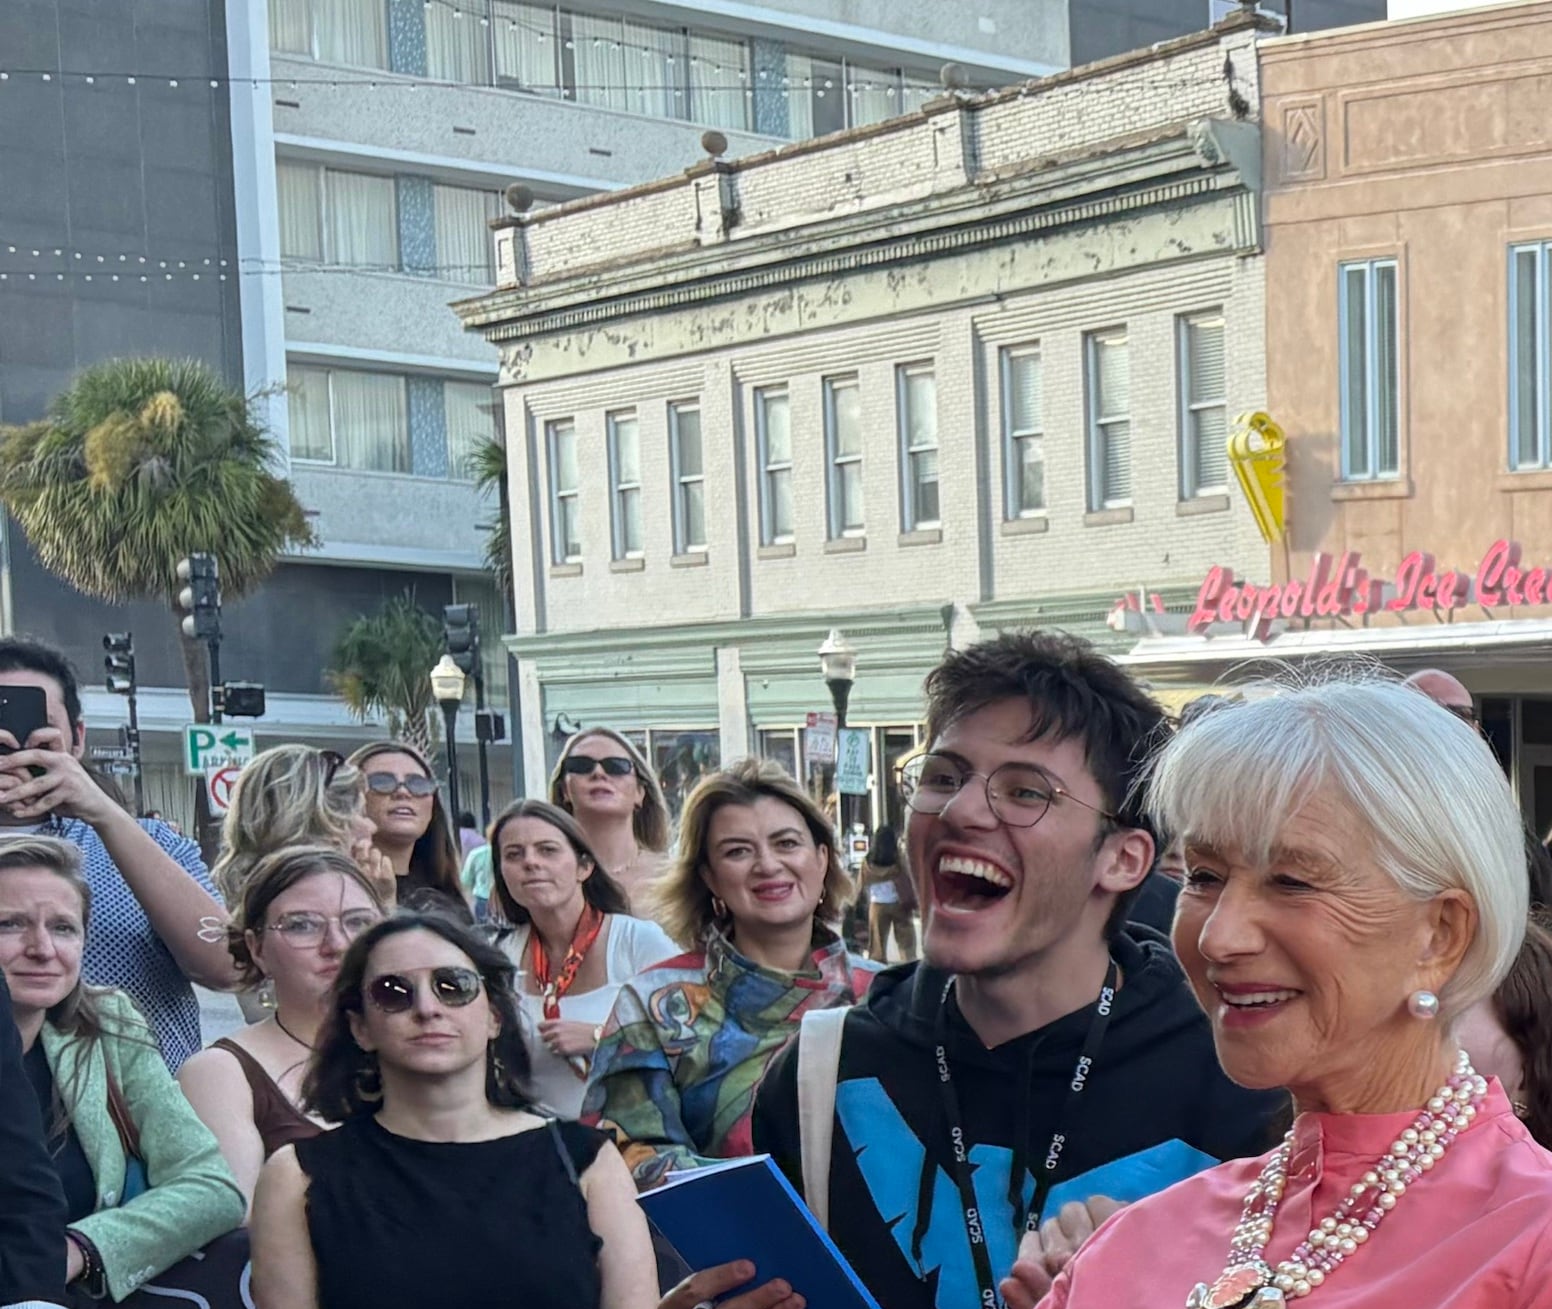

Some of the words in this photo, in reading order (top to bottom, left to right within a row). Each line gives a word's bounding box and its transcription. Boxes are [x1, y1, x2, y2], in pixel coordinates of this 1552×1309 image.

[1187, 551, 1370, 642] Leopold's
[1386, 551, 1460, 610] Ice
[1098, 986, 1115, 1016] SCAD
[935, 1045, 951, 1082] SCAD
[1071, 1055, 1093, 1092] SCAD
[951, 1126, 967, 1163] SCAD
[1045, 1133, 1066, 1170] SCAD
[966, 1207, 983, 1244] SCAD
[1026, 1212, 1039, 1231] SC
